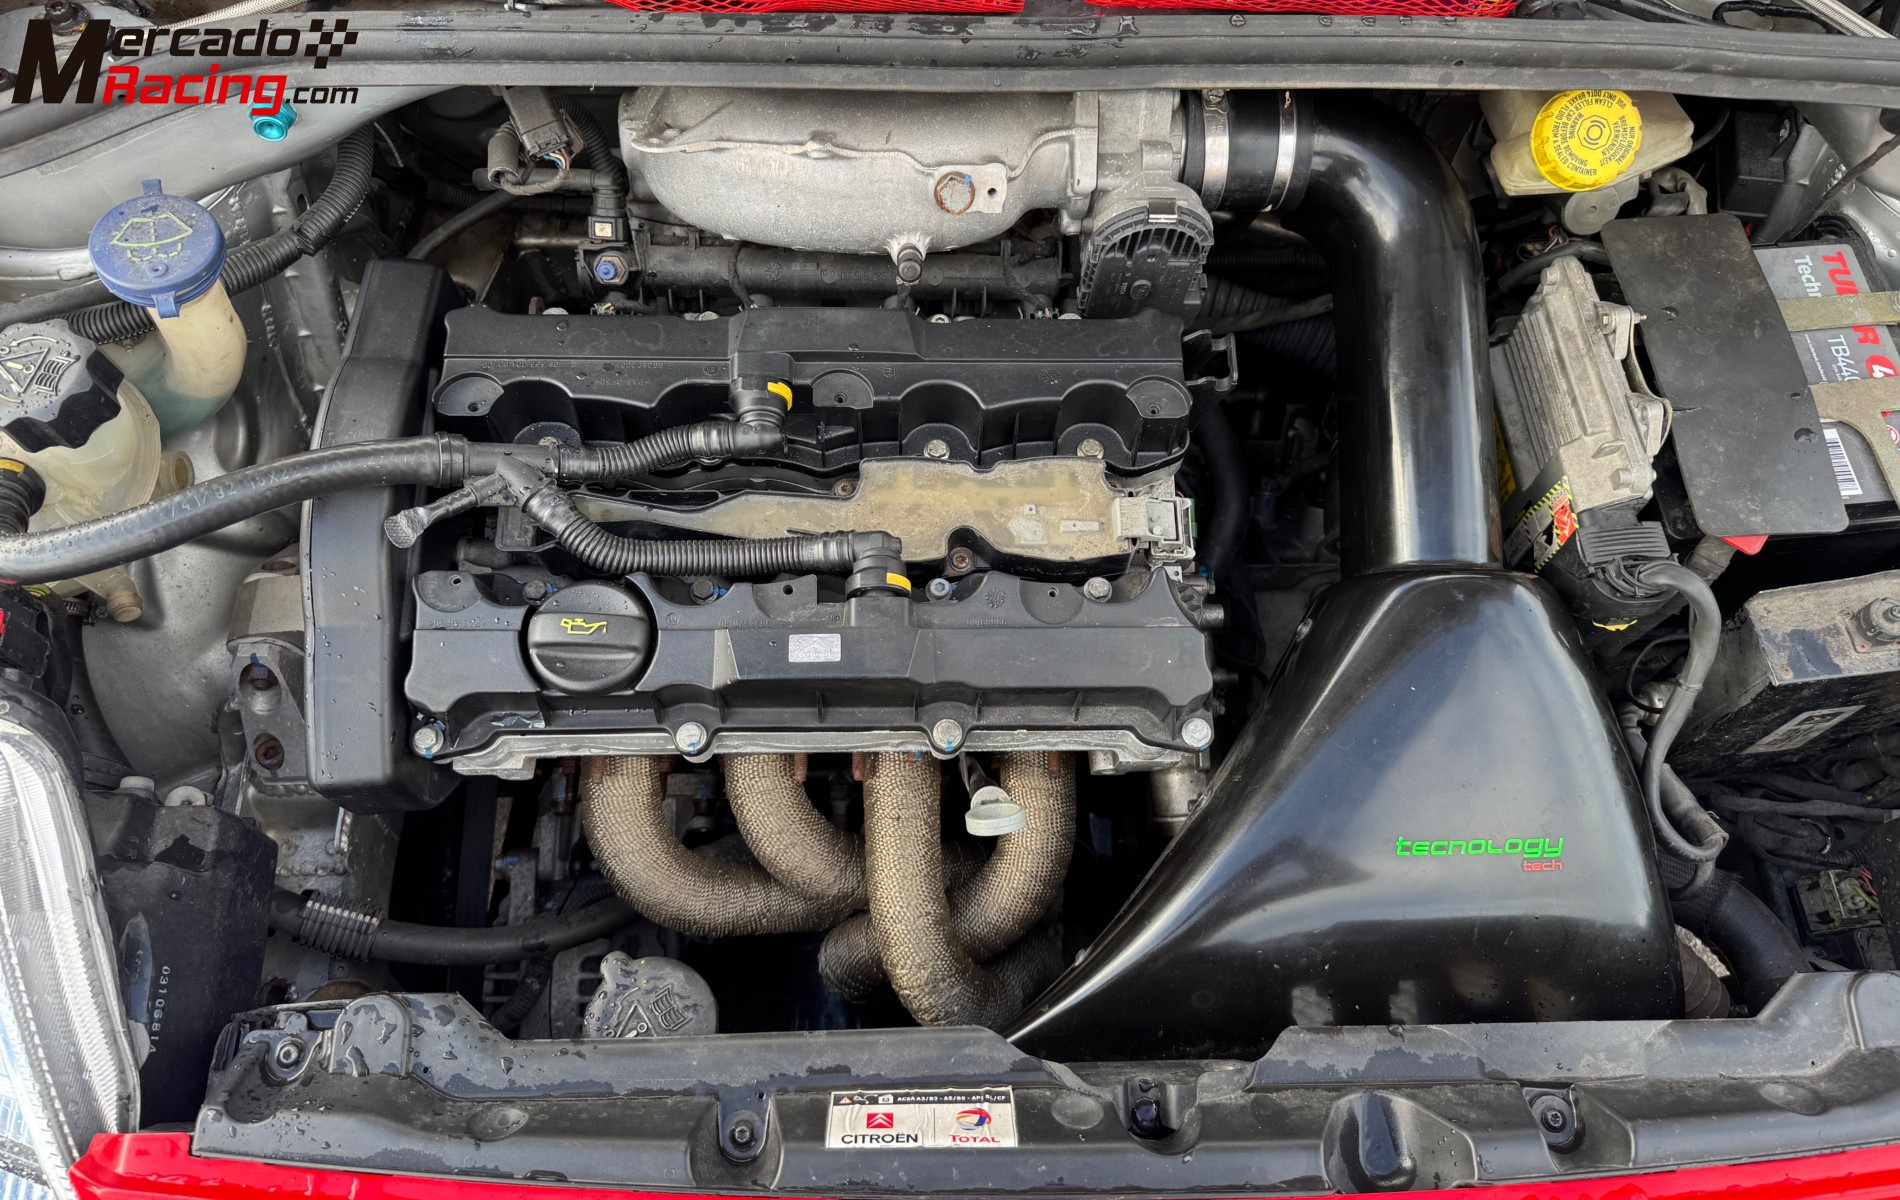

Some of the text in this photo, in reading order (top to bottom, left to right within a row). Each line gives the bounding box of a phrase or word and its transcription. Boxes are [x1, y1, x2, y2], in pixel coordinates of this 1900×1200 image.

[1567, 92, 1587, 107] BRAKE
[1602, 91, 1617, 101] ONLY
[1615, 98, 1627, 110] USE
[1555, 104, 1570, 121] FLUID
[1552, 121, 1560, 139] FROM
[1560, 98, 1613, 167] CLEAN FILLER CAP BEFORE REMOVING
[1568, 112, 1584, 139] WARNING
[1601, 121, 1620, 156] VERWENDEN
[1554, 144, 1569, 165] SEALED
[1615, 140, 1633, 165] ORIGINAL
[1567, 161, 1597, 176] CONTAINER
[1522, 859, 1563, 871] tech
[841, 1132, 918, 1144] CITROËN
[950, 1134, 1001, 1143] TOTAL
